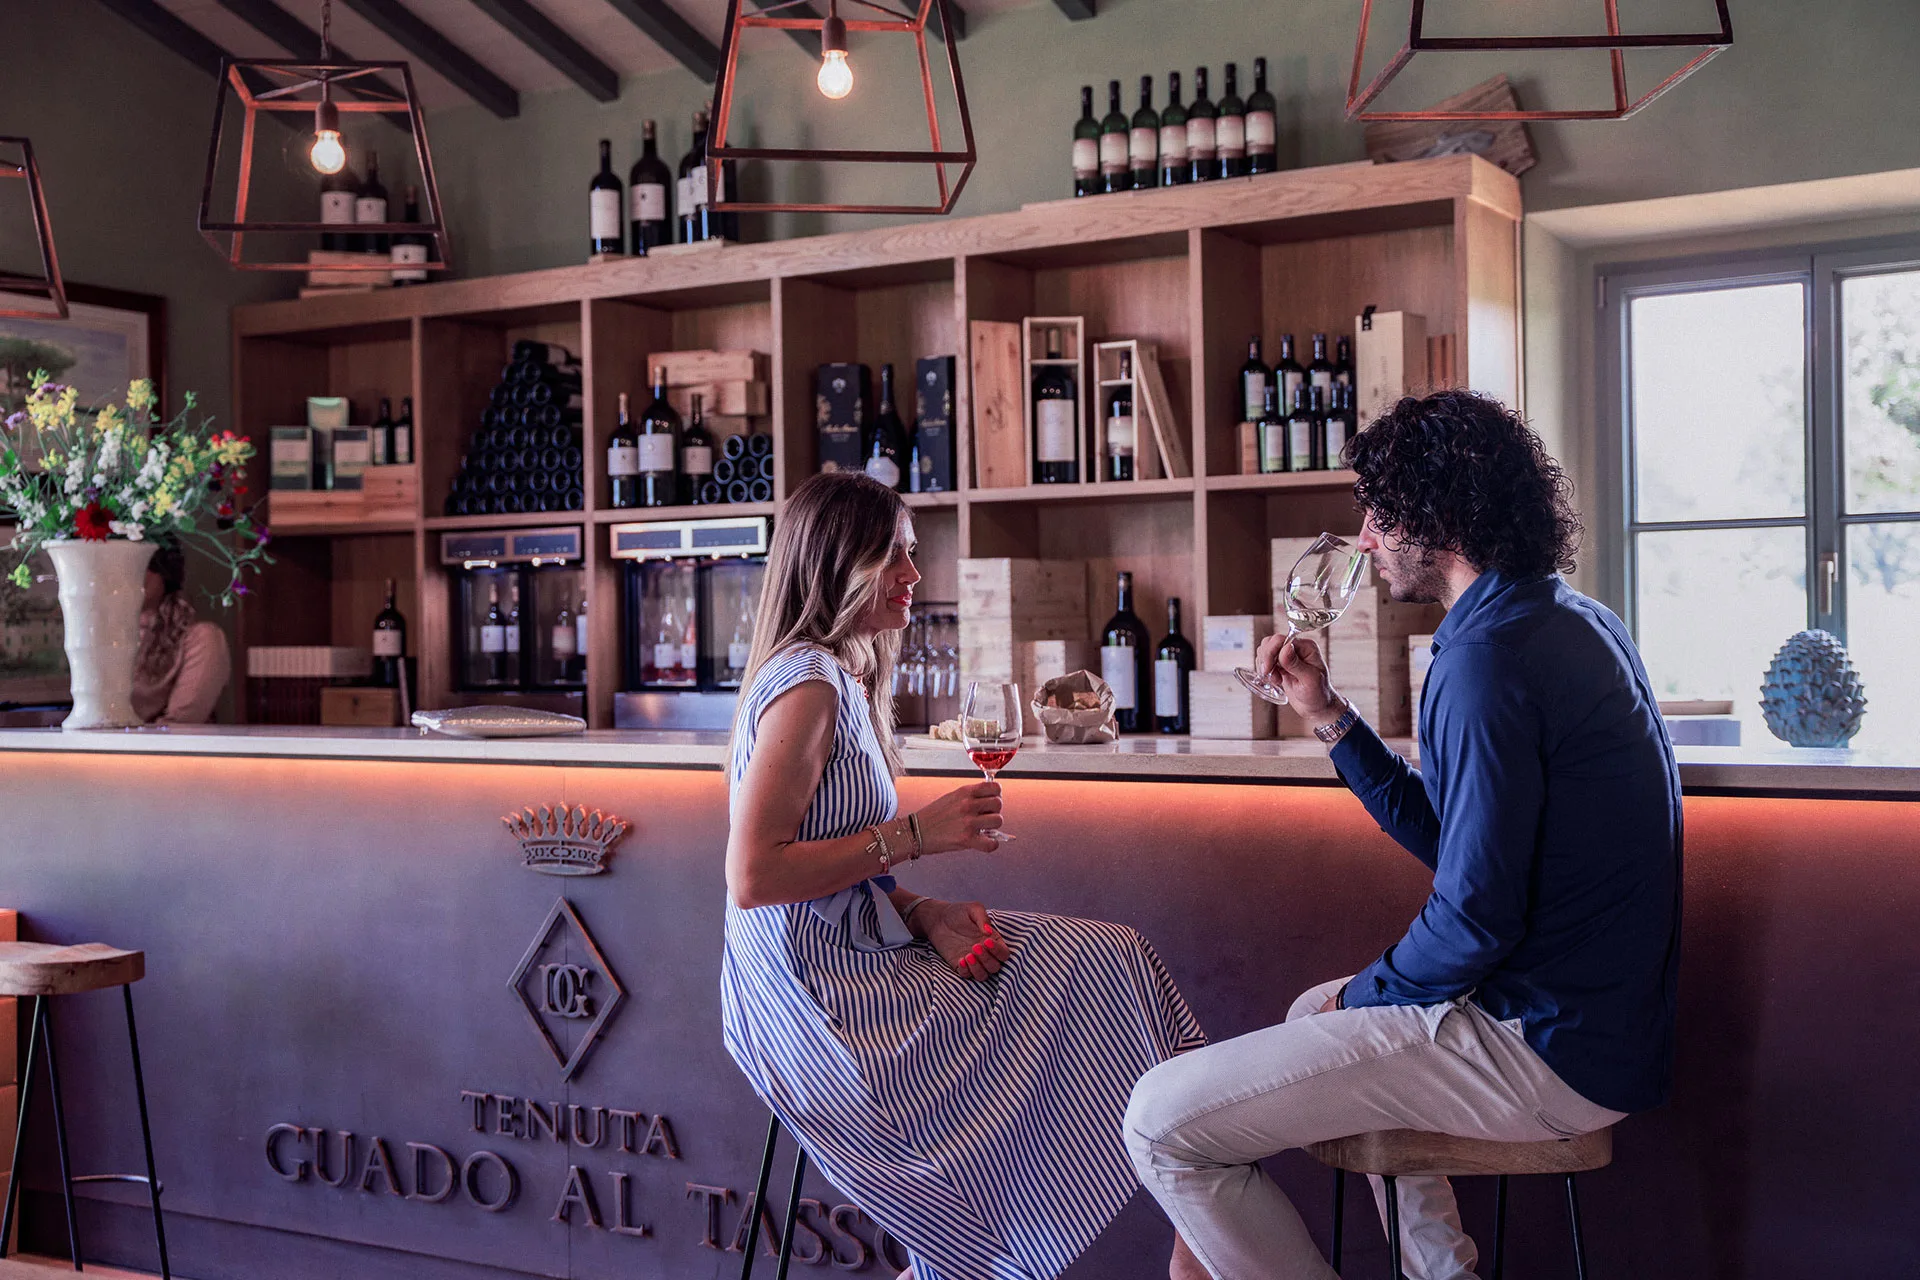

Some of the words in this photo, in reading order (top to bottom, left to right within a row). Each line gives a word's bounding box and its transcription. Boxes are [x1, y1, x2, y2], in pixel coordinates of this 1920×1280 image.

[461, 1089, 677, 1159] TENUTA
[265, 1122, 514, 1212] GUADO
[549, 1164, 645, 1237] AL
